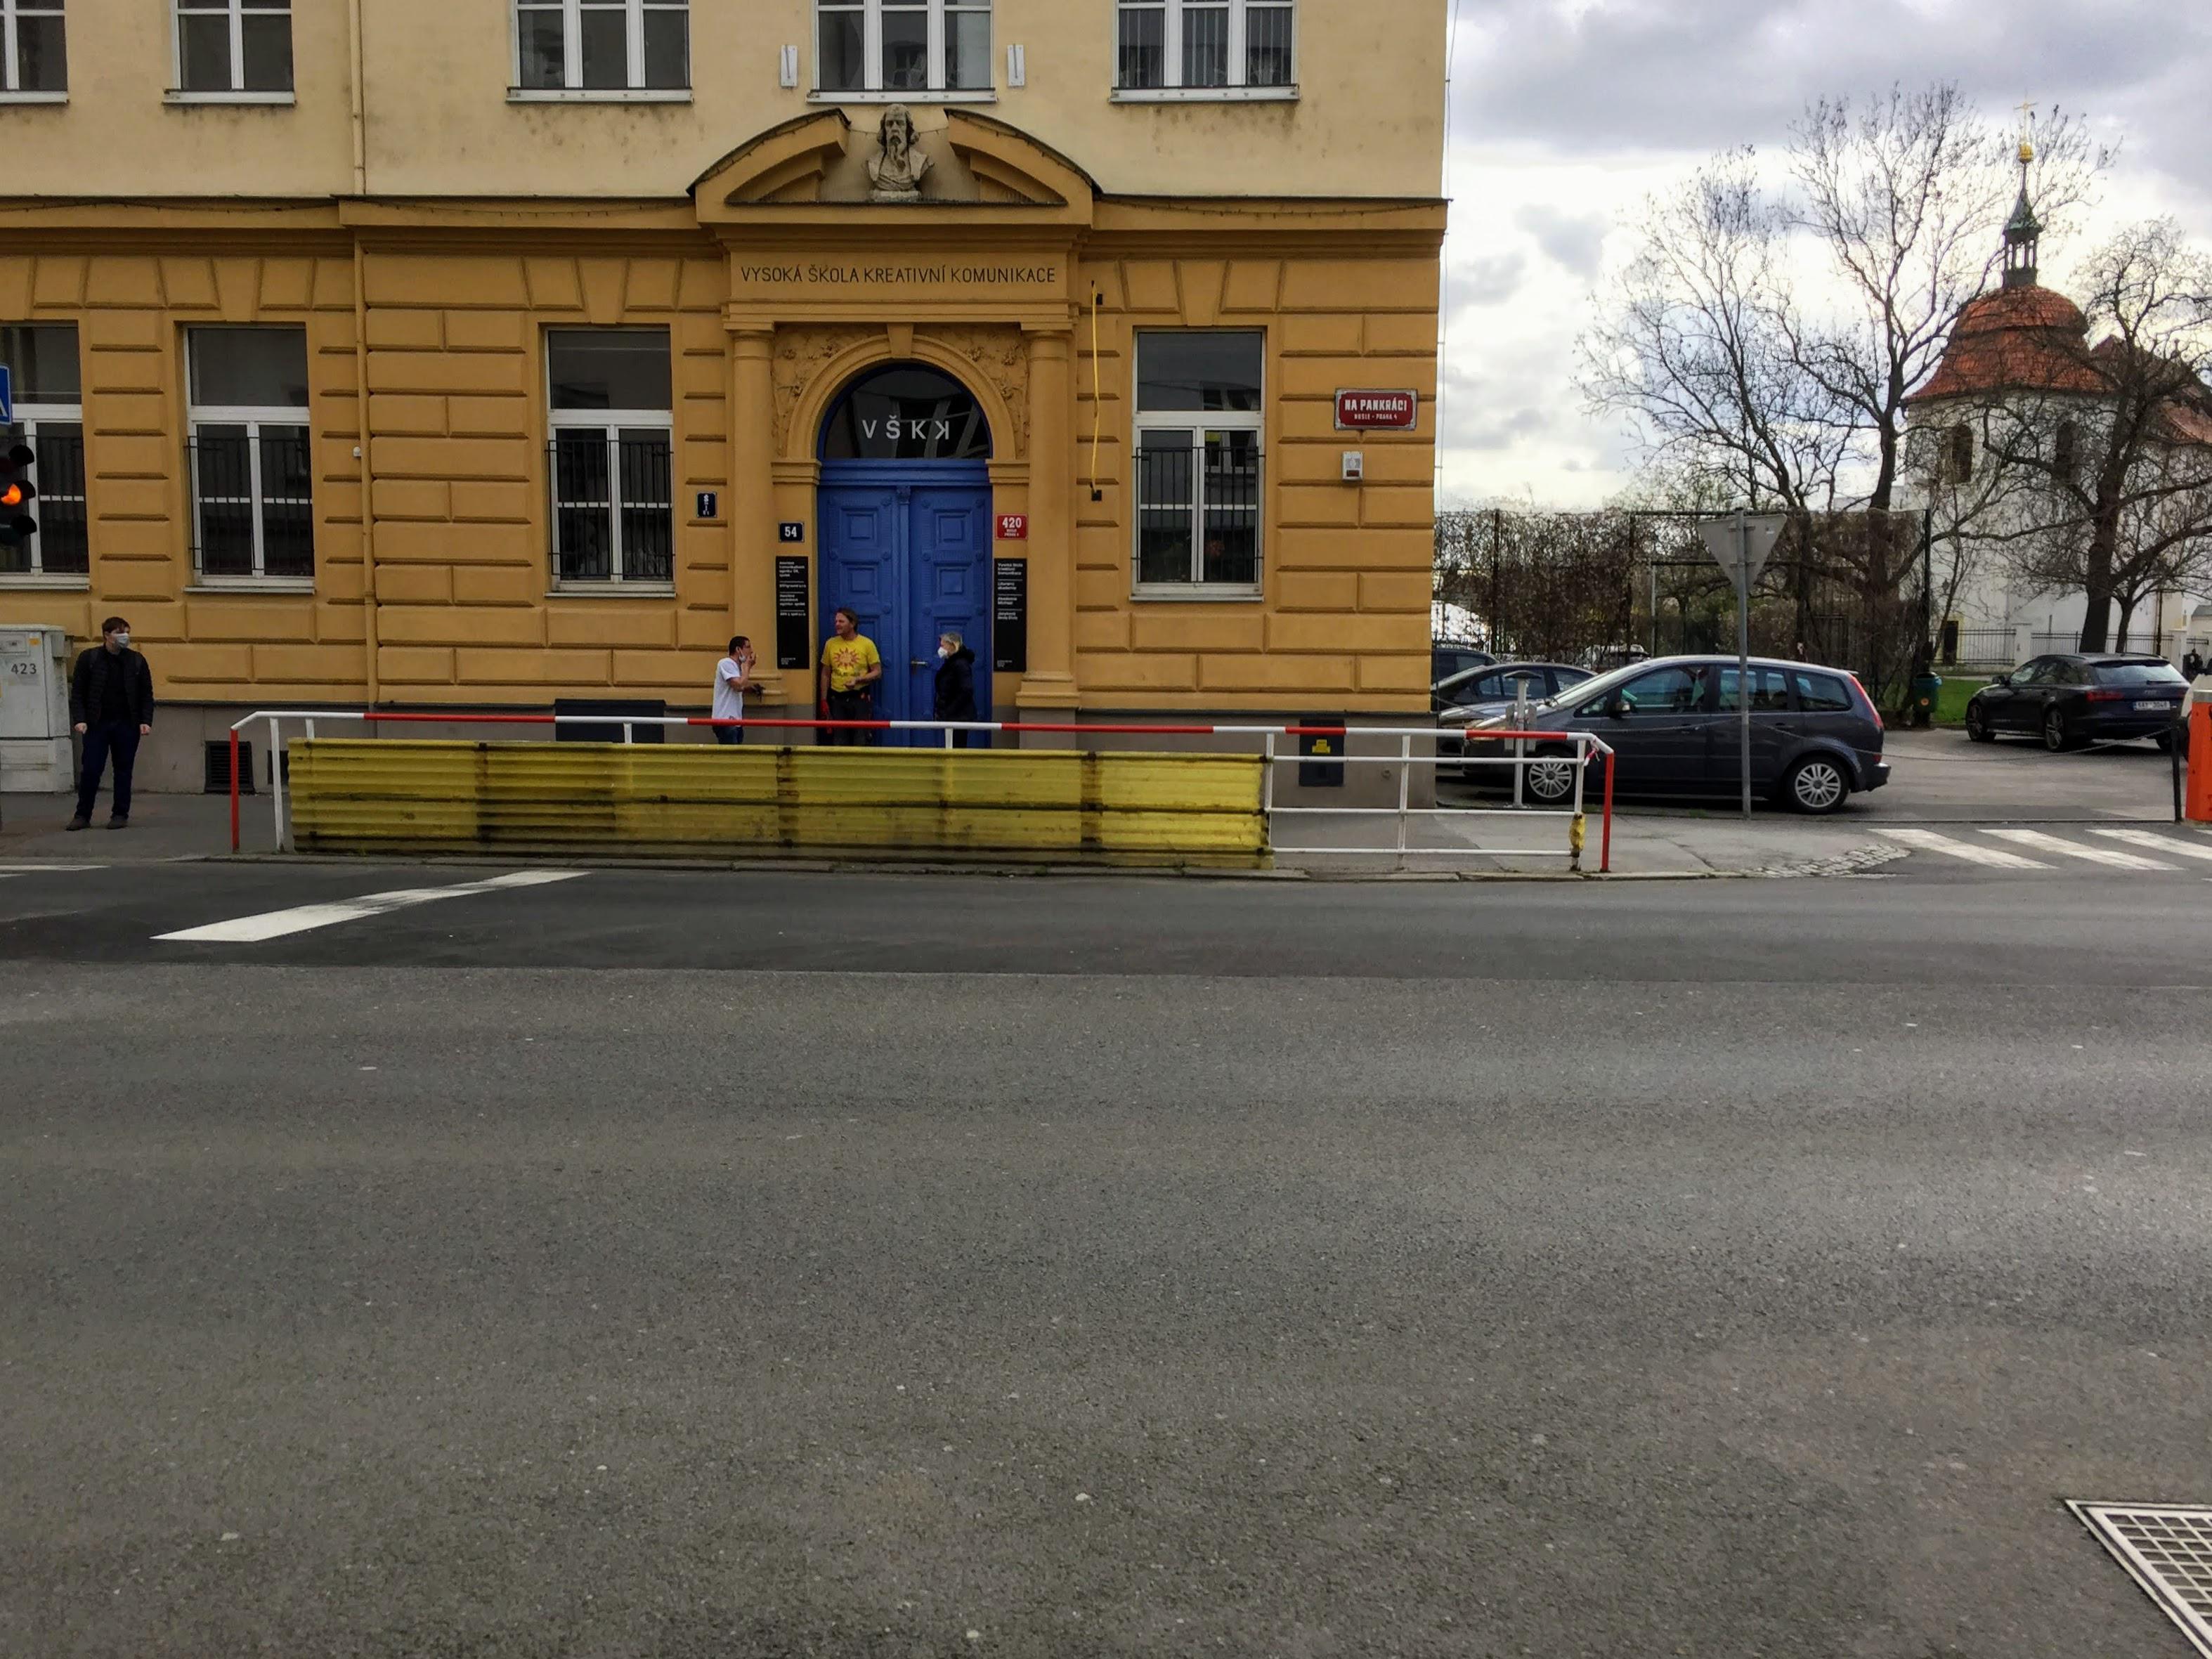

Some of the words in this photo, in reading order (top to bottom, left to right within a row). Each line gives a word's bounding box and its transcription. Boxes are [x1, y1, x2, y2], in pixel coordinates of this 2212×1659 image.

[741, 264, 802, 282] VYSOKÁ
[808, 264, 859, 282] ŠKOLA
[864, 264, 946, 282] KREATIVNÍ
[951, 268, 1055, 283] KOMUNIKACE
[1345, 399, 1357, 411] NA
[1360, 396, 1407, 412] PANKRÁCI
[1002, 516, 1022, 528] 420
[784, 526, 798, 538] 54
[11, 663, 37, 675] 423
